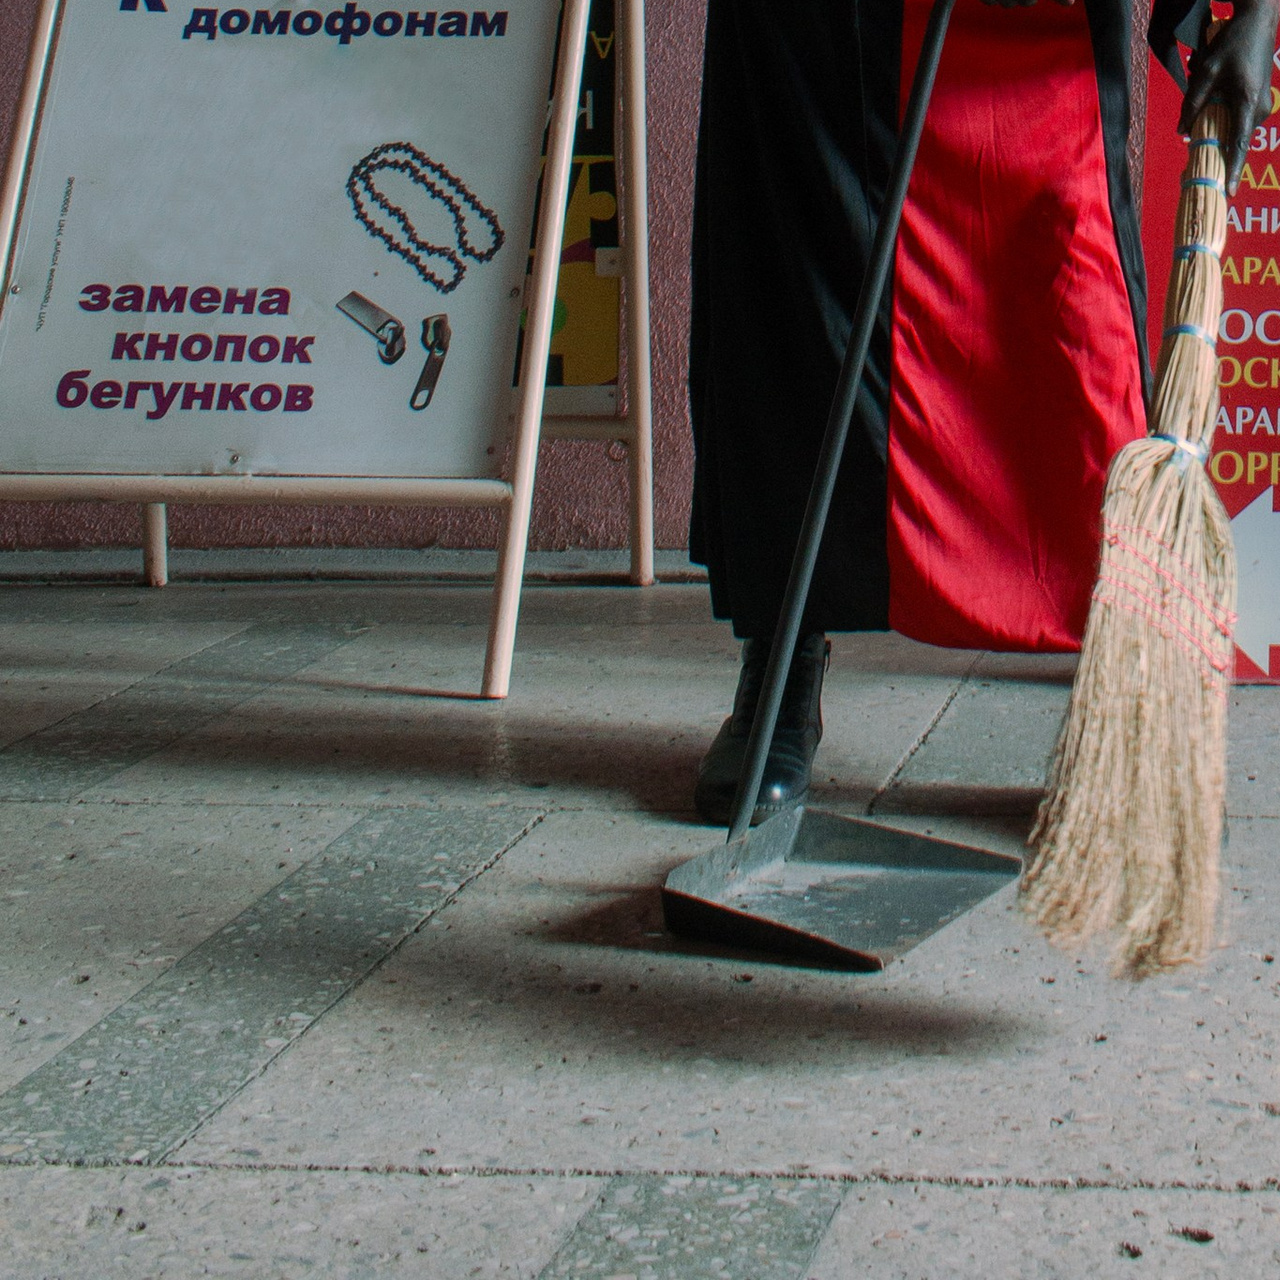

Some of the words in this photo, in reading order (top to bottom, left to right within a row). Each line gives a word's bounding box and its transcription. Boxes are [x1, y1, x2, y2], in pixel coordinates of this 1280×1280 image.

[182, 2, 509, 45] домофонам
[78, 283, 292, 315] замена
[111, 331, 315, 364] кнопок
[55, 369, 315, 420] бегунков
